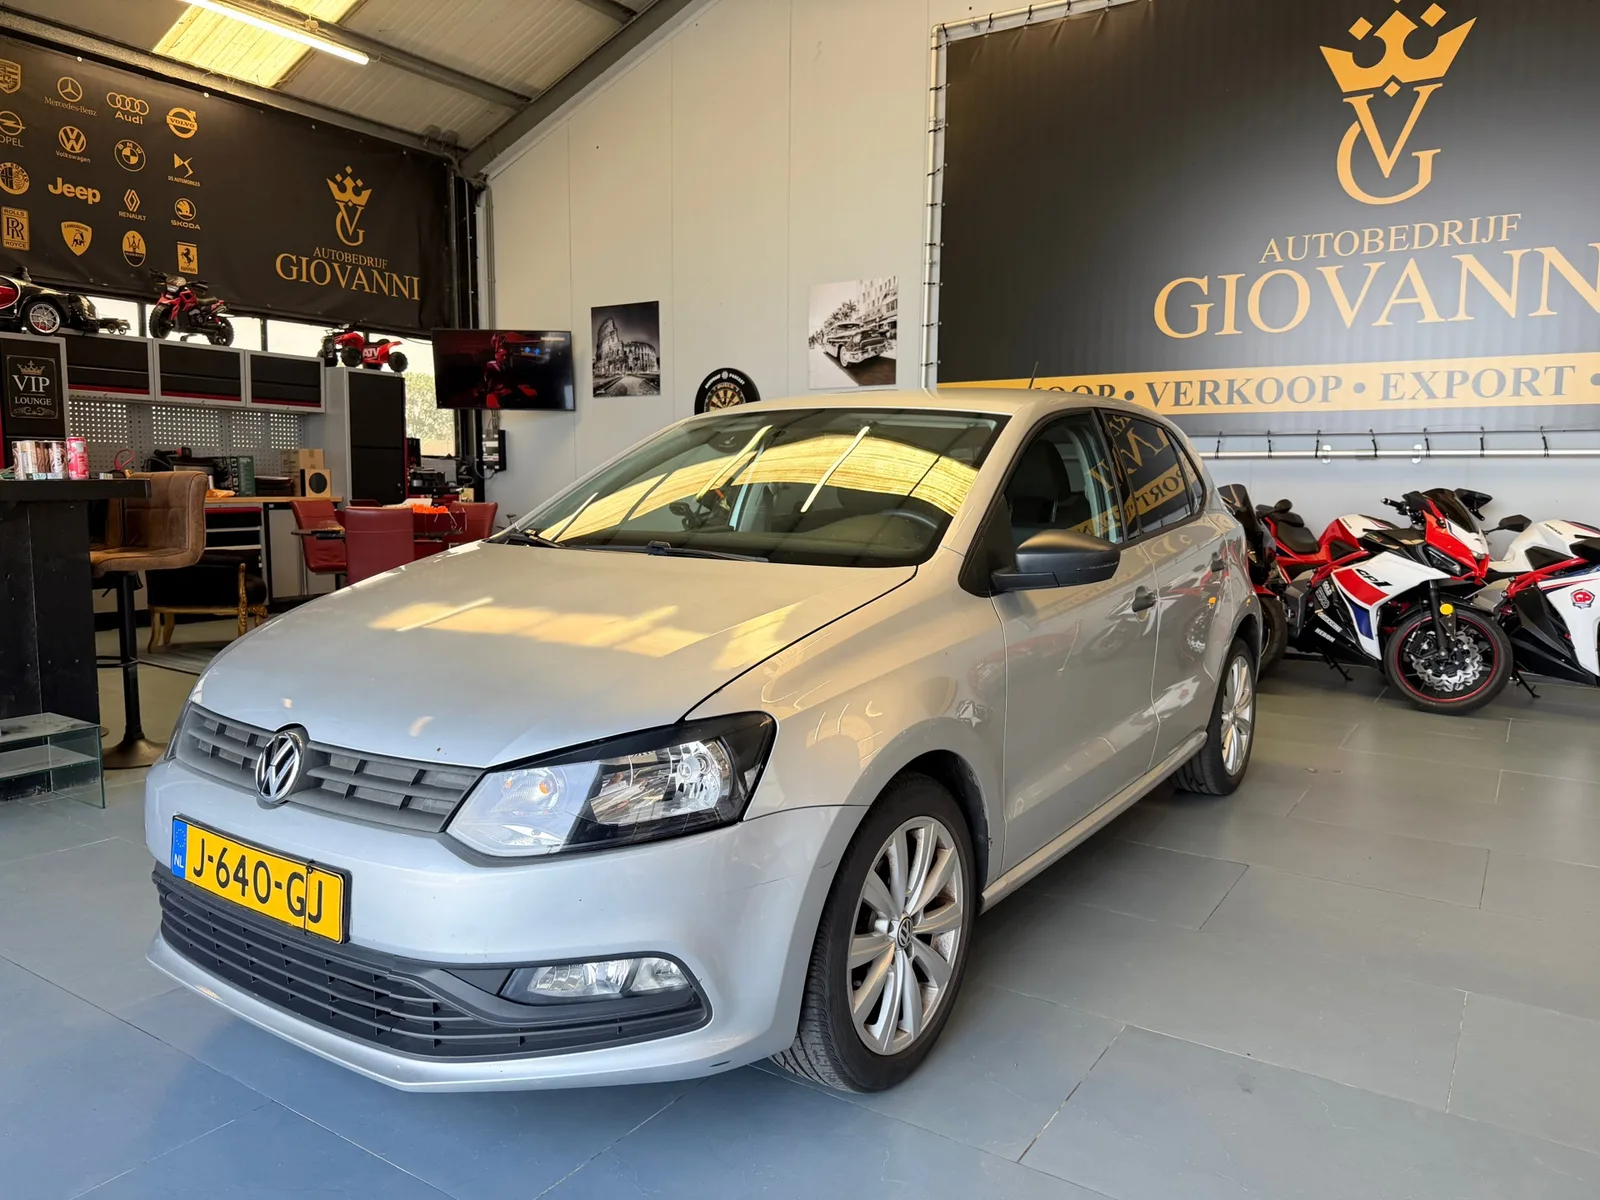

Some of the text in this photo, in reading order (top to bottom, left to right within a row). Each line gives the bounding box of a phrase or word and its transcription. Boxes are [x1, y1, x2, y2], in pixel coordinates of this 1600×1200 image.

[44, 96, 97, 116] Mercedes-Benz
[115, 111, 143, 125] Audi
[169, 118, 195, 129] VOLVO
[0, 134, 24, 147] OPEL
[117, 142, 143, 155] BMW
[56, 150, 91, 163] Volkswagen
[174, 177, 201, 187] AUTOMOBILES
[48, 177, 101, 205] Jeep
[3, 208, 25, 217] ROLLS
[118, 211, 147, 221] RENAULT
[5, 241, 27, 249] ROYCE
[1258, 213, 1522, 264] AUTOBEDRIJF
[313, 247, 388, 270] AUTOBEDRIJF
[275, 253, 421, 301] GIOVANNI
[362, 347, 380, 358] ATV
[12, 374, 50, 393] VIP
[1144, 365, 1576, 408] VERKOOP EXPORT
[14, 396, 52, 406] LOUNGE
[174, 853, 184, 868] NL
[193, 838, 323, 924] J-640-GJ
